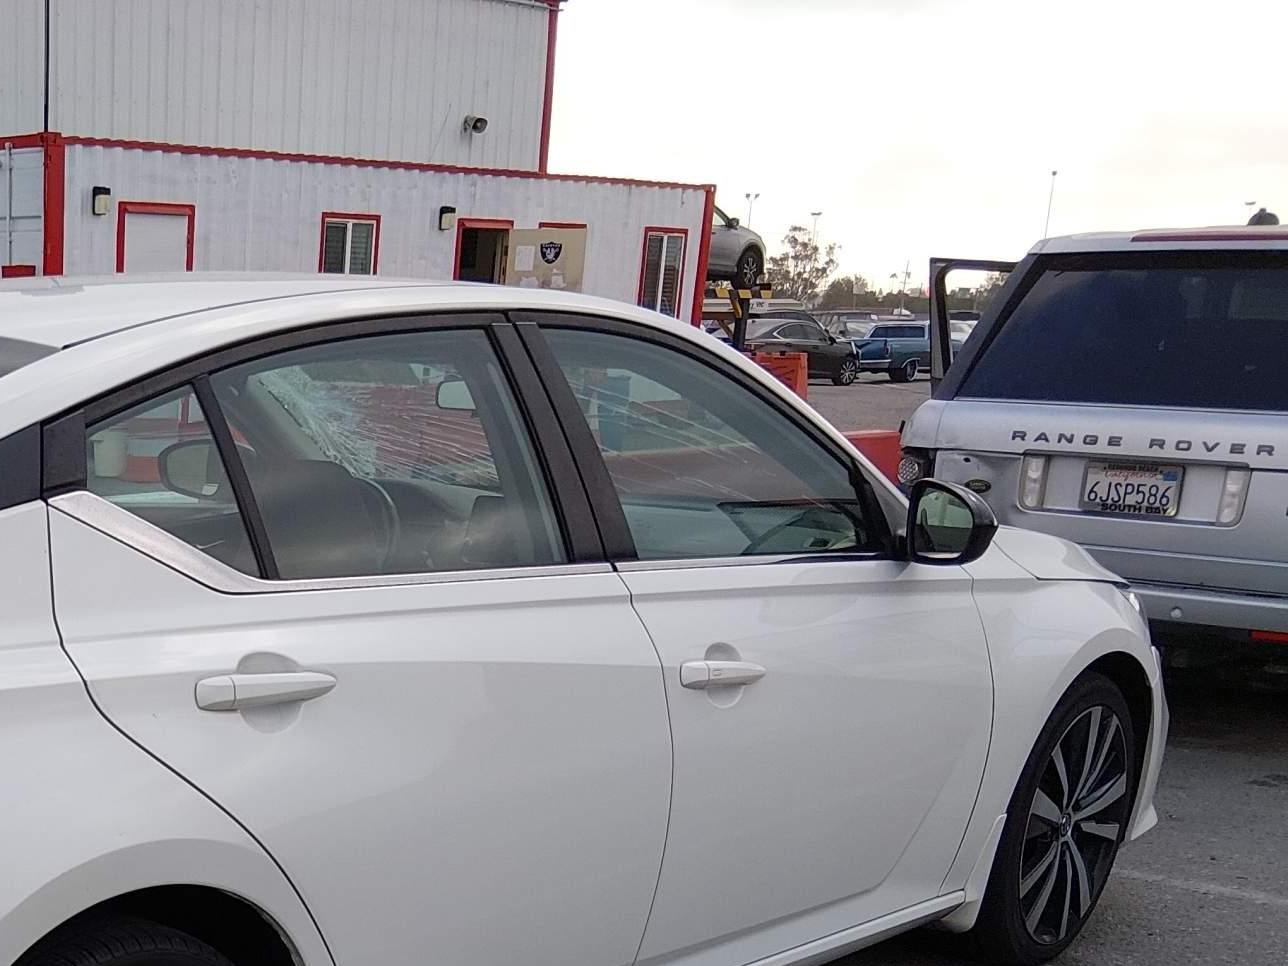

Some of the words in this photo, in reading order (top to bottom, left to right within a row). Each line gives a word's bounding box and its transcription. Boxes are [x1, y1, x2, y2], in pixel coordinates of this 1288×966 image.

[1011, 430, 1123, 447] RANGE
[1148, 438, 1276, 456] ROVER
[1087, 481, 1172, 507] 6JSP586
[1101, 503, 1142, 514] SOUTH
[1145, 506, 1169, 515] BAY
